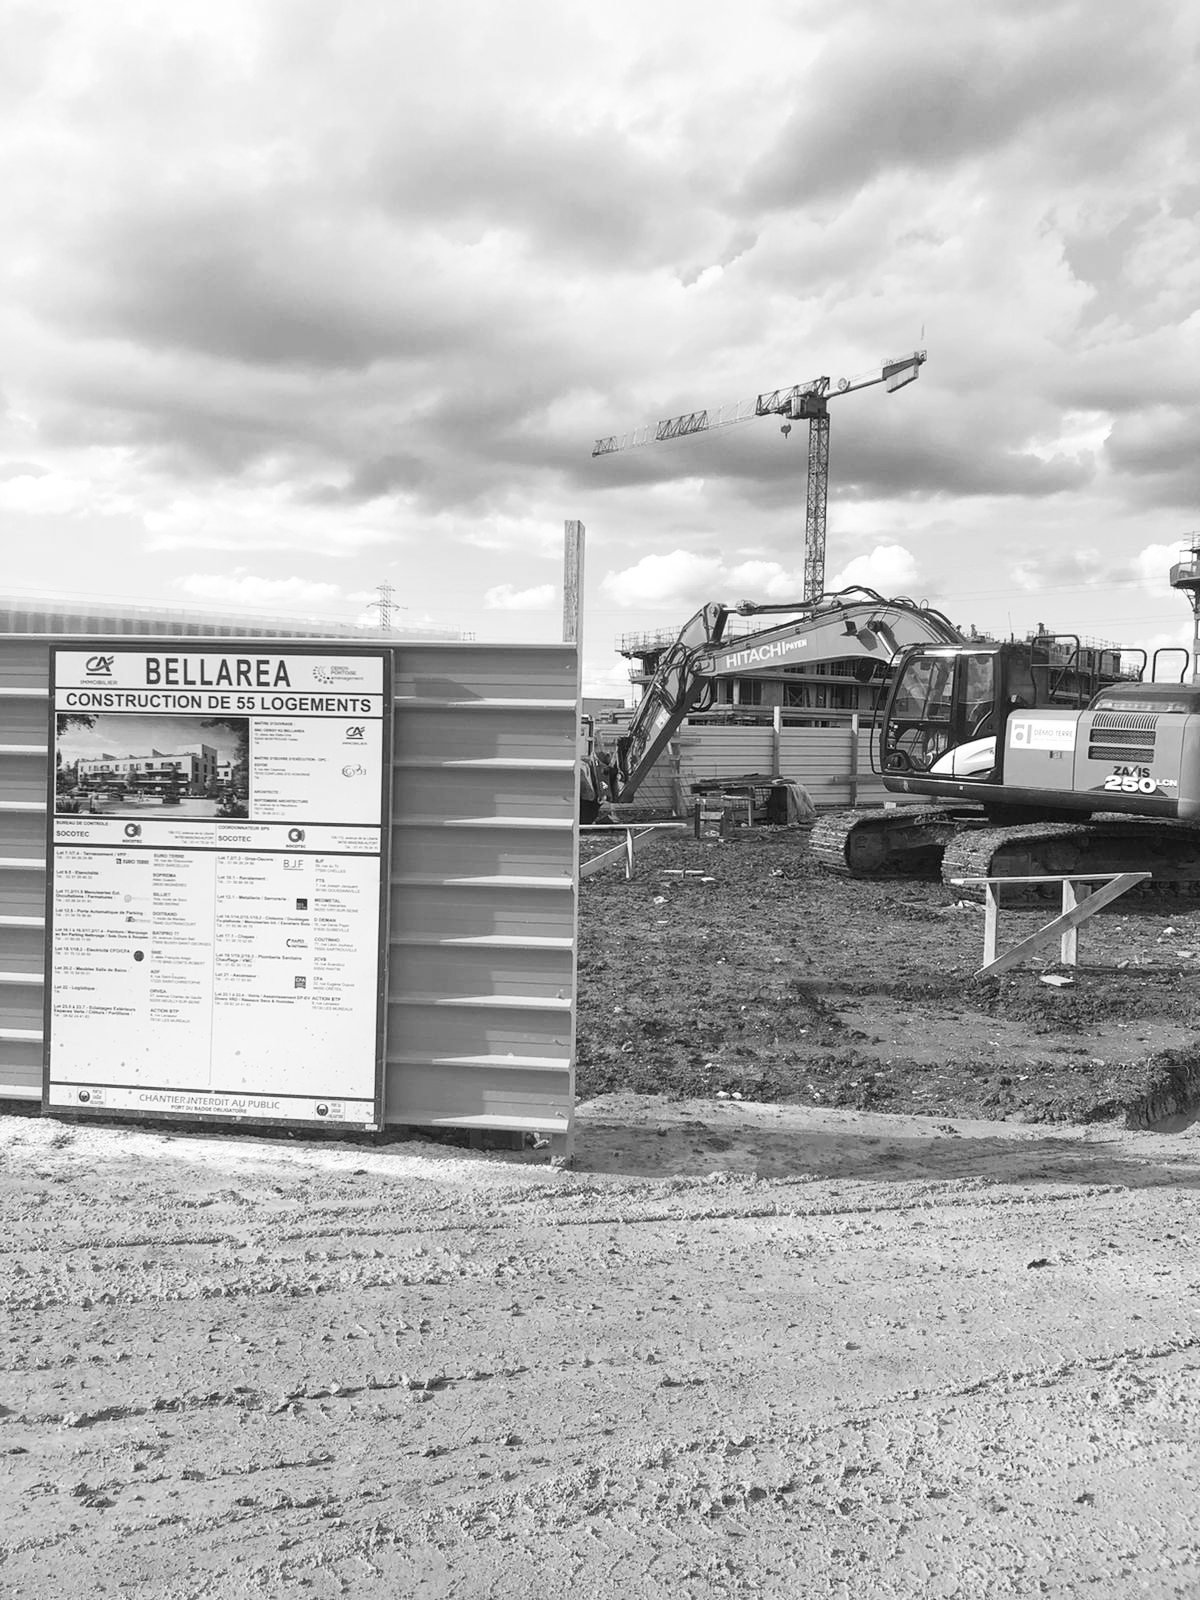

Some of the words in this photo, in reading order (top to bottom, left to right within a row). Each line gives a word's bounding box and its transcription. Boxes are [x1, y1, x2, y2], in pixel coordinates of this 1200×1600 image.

[726, 641, 786, 668] HITACHI
[786, 638, 807, 652] PAYEN
[146, 657, 291, 688] BELLAREA
[66, 693, 202, 709] CONSTRUCTION
[208, 695, 230, 709] DE
[237, 696, 255, 710] 55
[261, 697, 372, 713] LOGEMENTS
[1113, 765, 1150, 779] ZAXIS
[1104, 775, 1157, 795] 250
[1156, 779, 1177, 787] LCN
[56, 830, 90, 838] SOCOTEC
[139, 1093, 186, 1104] CHANTIER
[187, 1096, 229, 1107] INTERDIT
[232, 1099, 247, 1108] AU
[248, 1100, 280, 1110] PUBLIC
